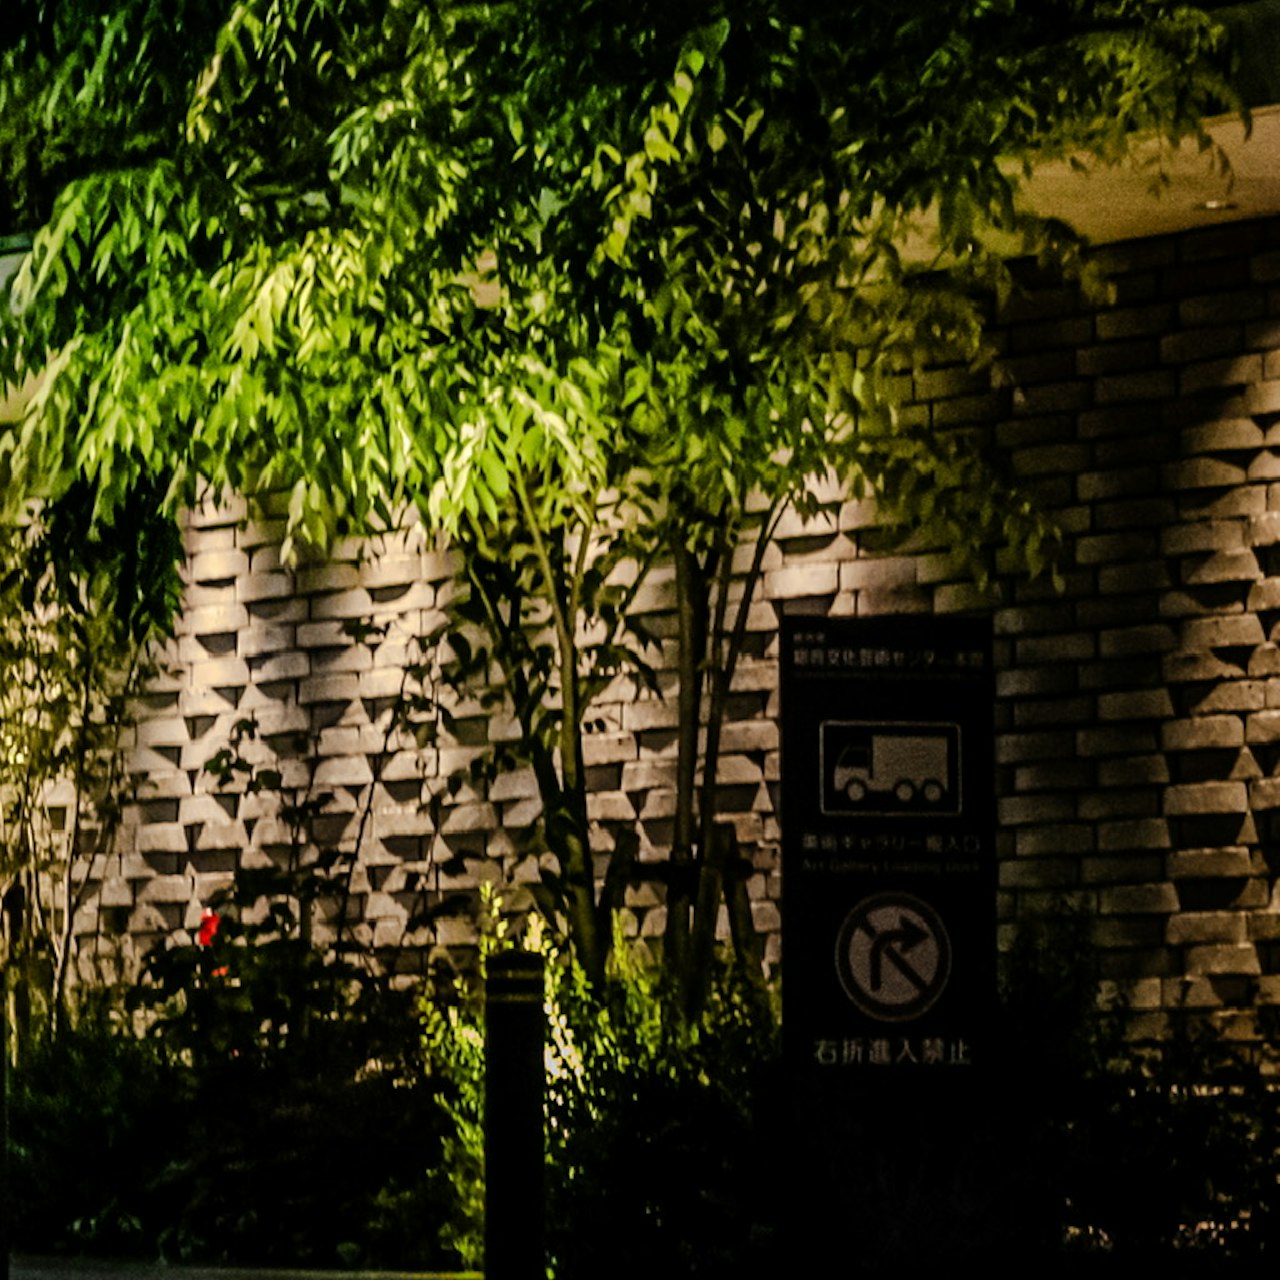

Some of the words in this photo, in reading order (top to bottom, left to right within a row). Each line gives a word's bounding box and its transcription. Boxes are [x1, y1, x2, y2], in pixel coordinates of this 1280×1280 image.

[814, 1037, 972, 1066] 右折進入禁止
